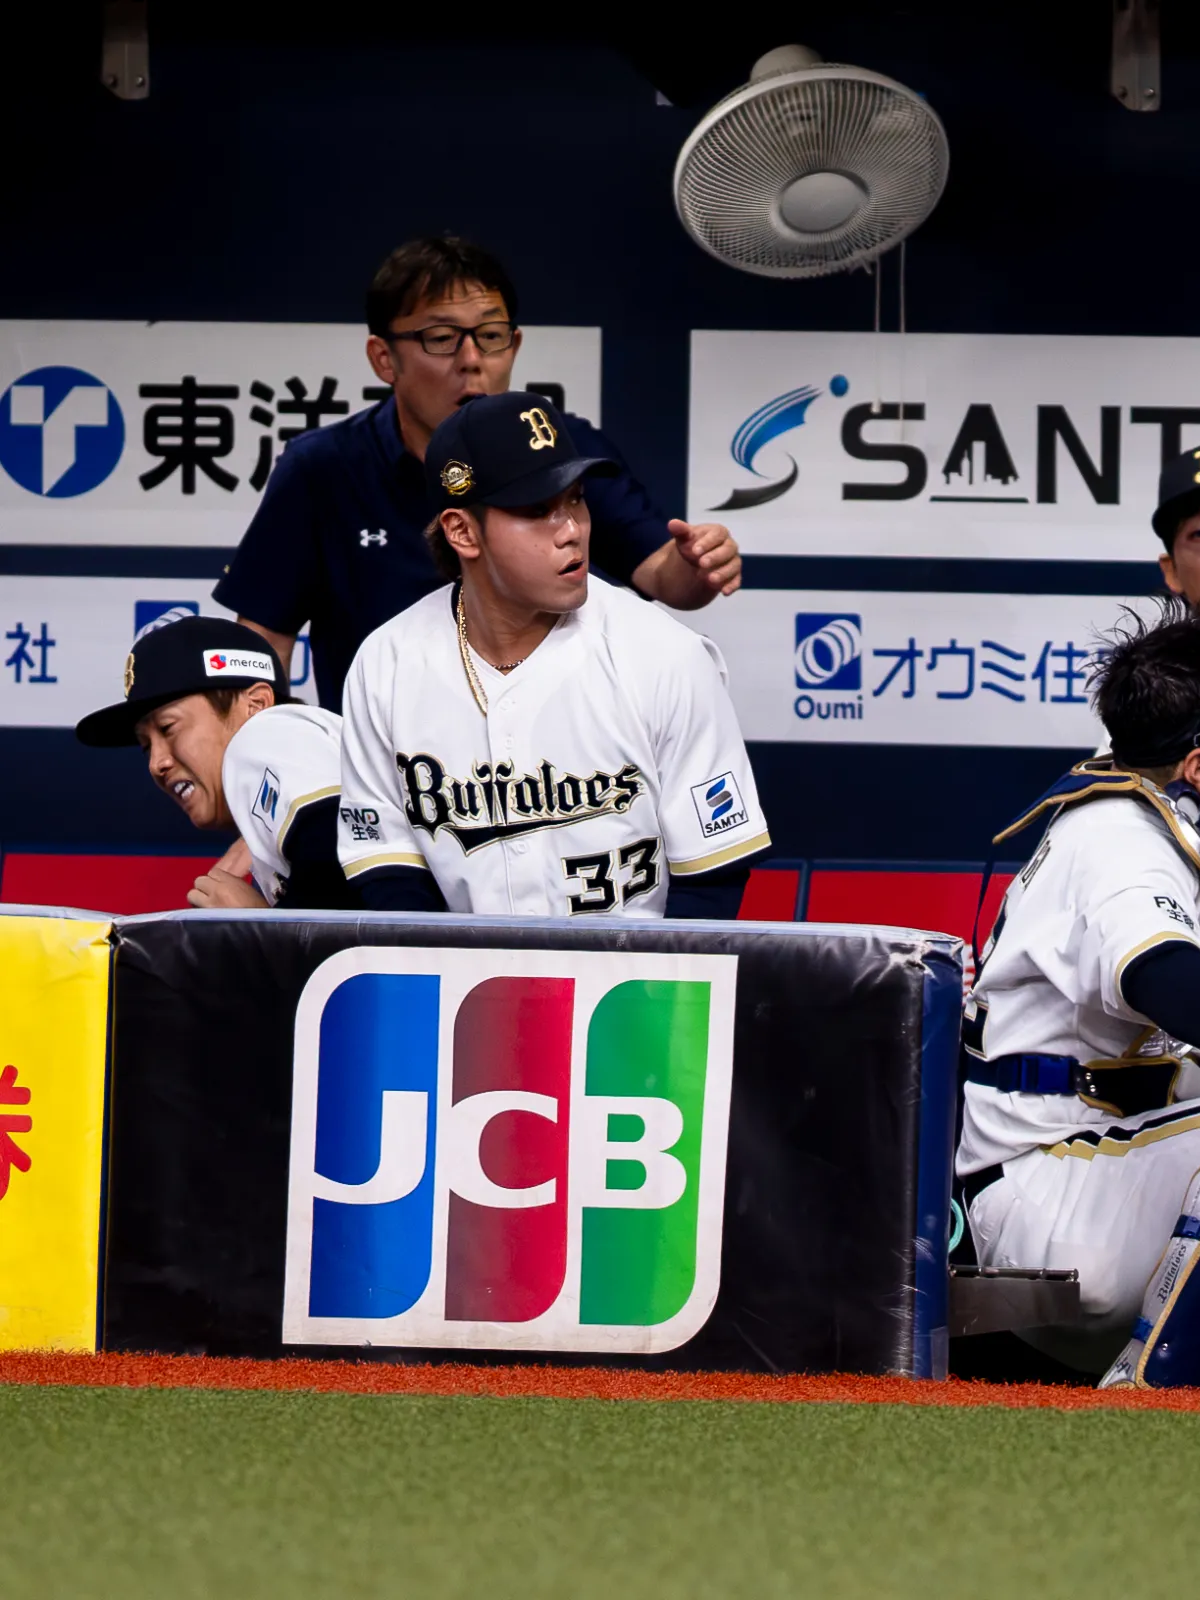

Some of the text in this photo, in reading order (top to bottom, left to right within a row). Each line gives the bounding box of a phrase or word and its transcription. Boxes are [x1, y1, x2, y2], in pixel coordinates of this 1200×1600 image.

[520, 408, 557, 450] B
[5, 622, 58, 683] 社
[229, 658, 272, 671] mercari
[872, 637, 1106, 703] オウミ住
[794, 695, 863, 719] Oumi
[396, 751, 647, 843] Buffaloes
[704, 809, 746, 835] SAMTY
[560, 836, 662, 916] 33
[313, 1090, 687, 1209] JCB
